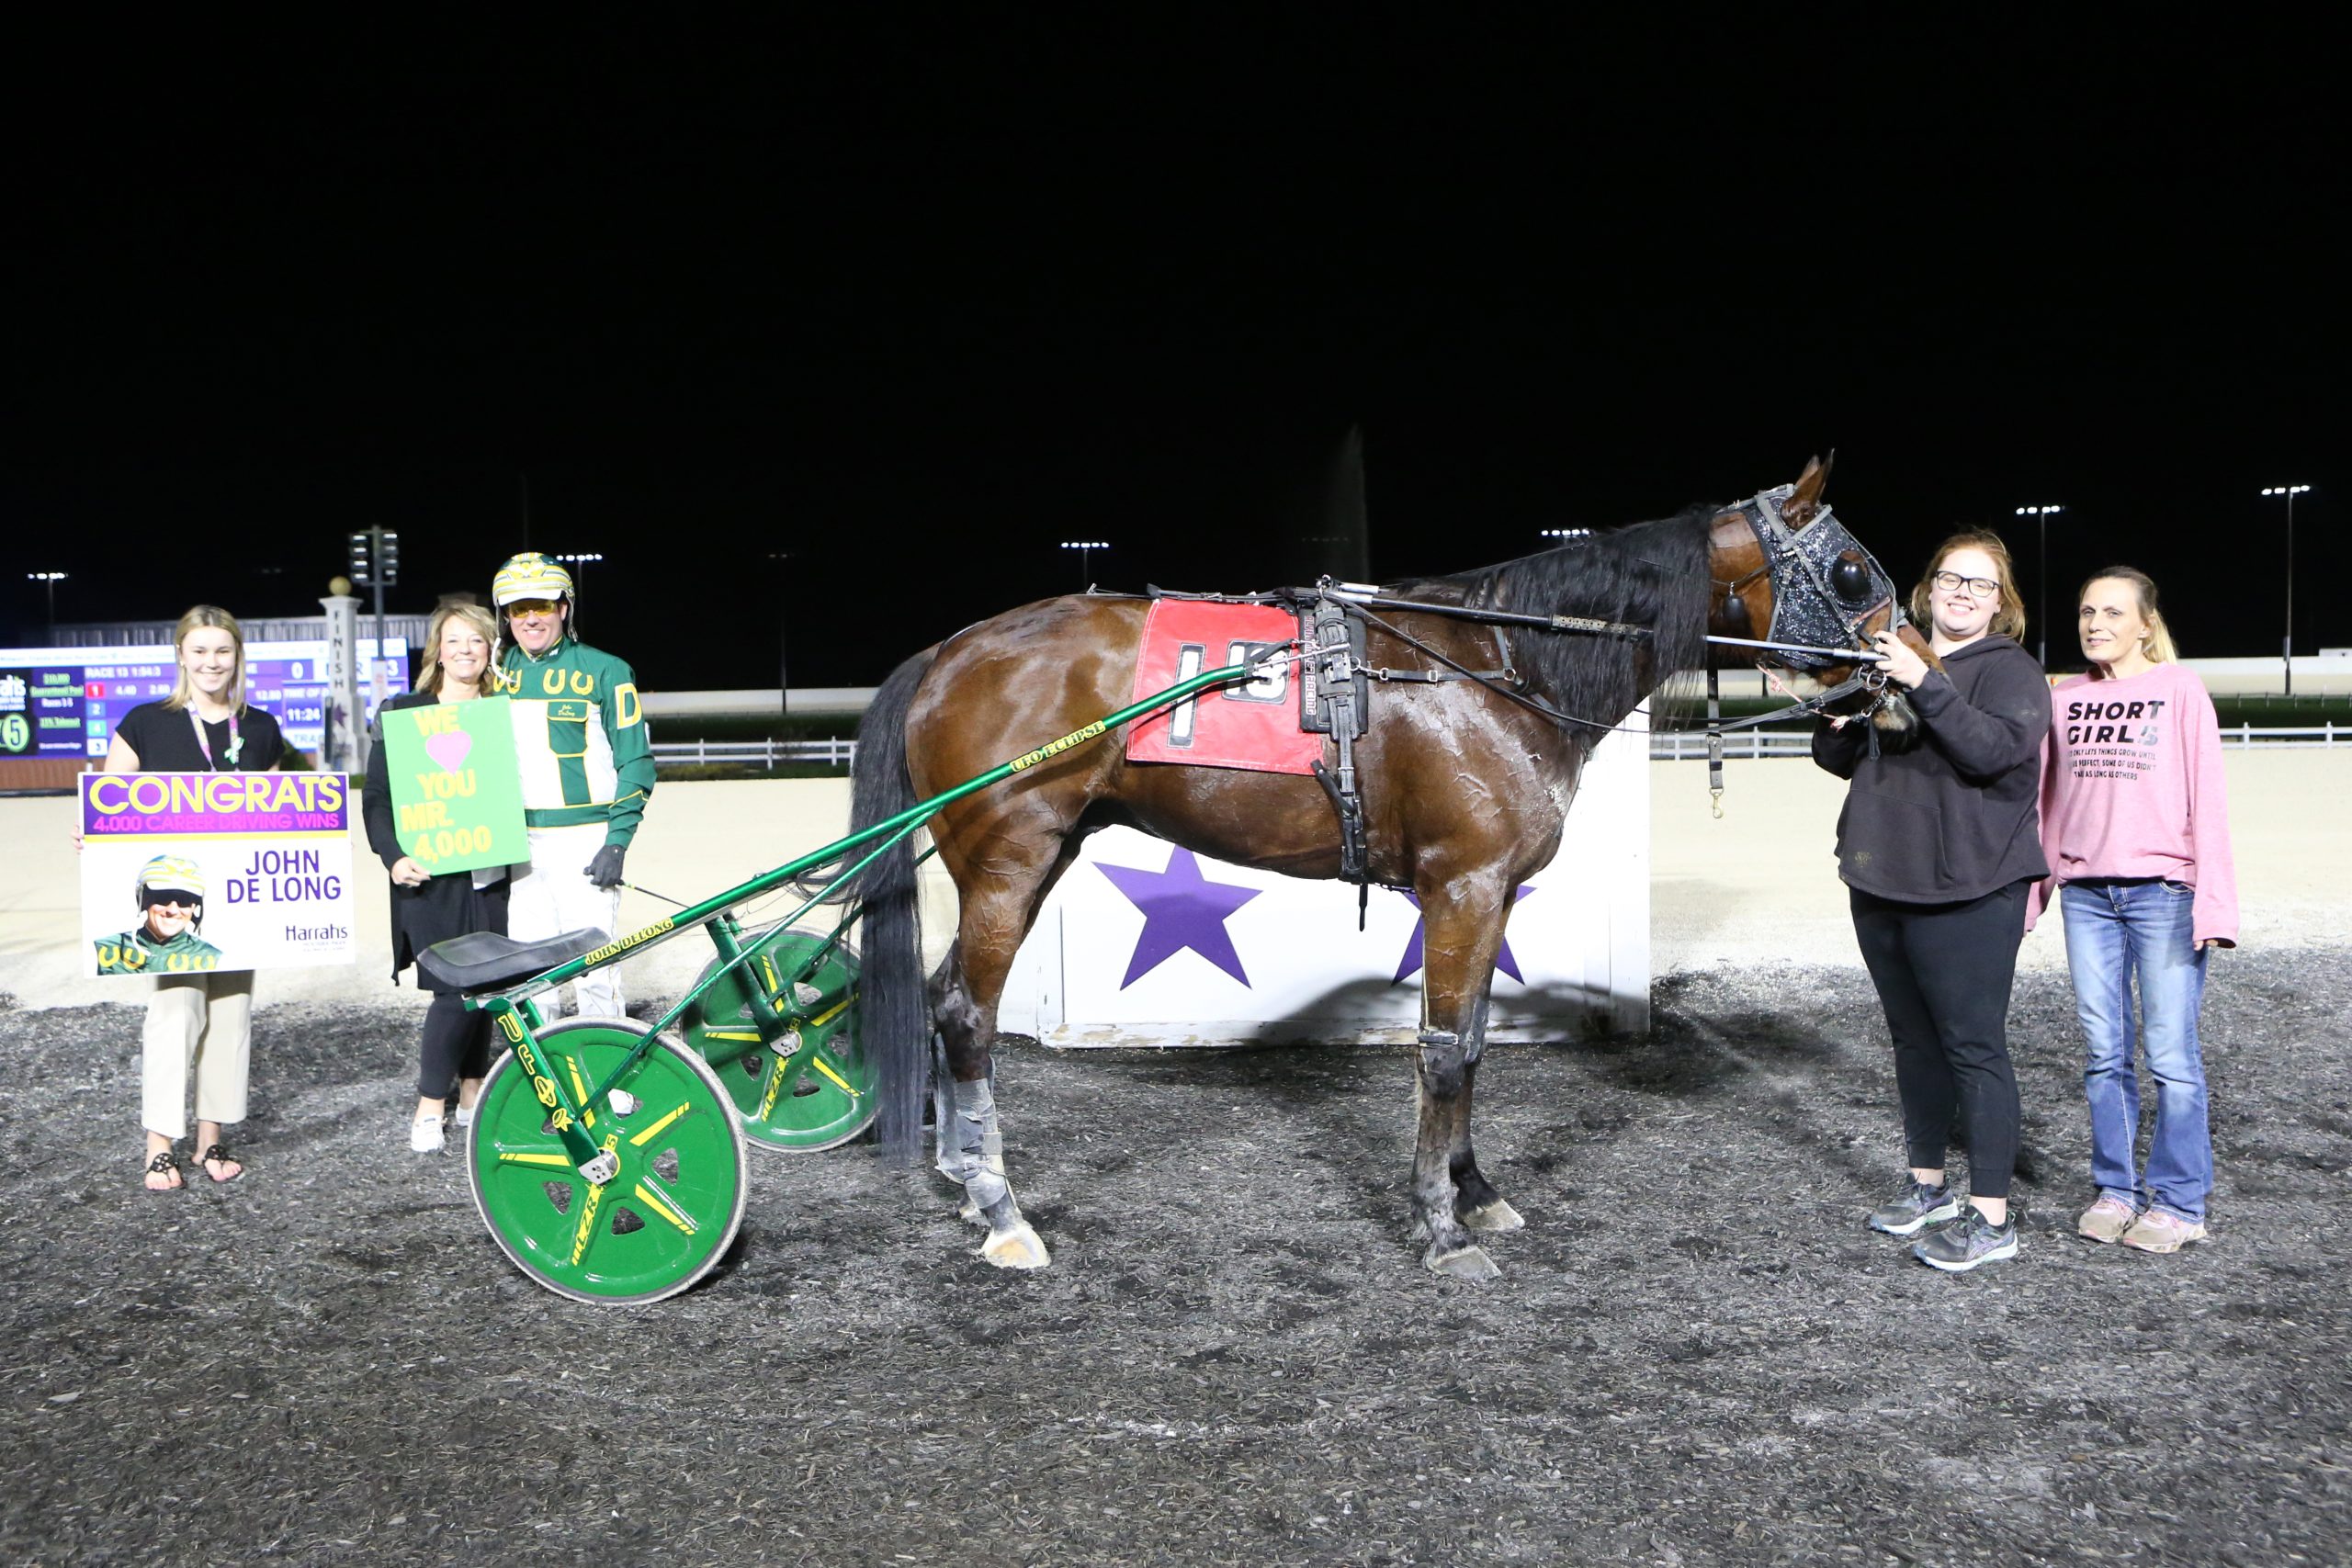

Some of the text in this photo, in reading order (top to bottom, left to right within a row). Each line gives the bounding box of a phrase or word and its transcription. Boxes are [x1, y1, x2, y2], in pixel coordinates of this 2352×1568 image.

[334, 609, 345, 689] FINISH
[85, 667, 115, 679] RACE
[615, 682, 642, 729] D
[1305, 675, 1317, 716] RACING
[287, 707, 322, 721] 11:24
[413, 705, 460, 736] WE
[2067, 701, 2165, 720] SHORT
[10, 719, 21, 746] 5
[1010, 720, 1105, 772] UFO ECLIPSE
[2067, 725, 2158, 746] GIRLS
[2085, 748, 2097, 756] LETS
[2098, 748, 2118, 756] THINGS
[2119, 749, 2137, 758] GROW
[2139, 750, 2156, 761] UNTIL
[2102, 759, 2117, 767] SOME
[2127, 761, 2135, 769] US
[415, 768, 477, 800] YOU
[2086, 770, 2093, 778] AS
[2094, 770, 2107, 778] LONG
[2109, 770, 2114, 778] AS
[2115, 771, 2138, 781] OTHERS
[89, 776, 343, 815] CONGRATS
[93, 813, 340, 831] 4,000 CAREER DRIVING WINS
[414, 825, 492, 863] 4,000
[245, 850, 320, 875] JOHN
[227, 875, 341, 903] DE LONG
[585, 918, 673, 964] JOHN DELONG
[576, 1197, 598, 1250] LZR
